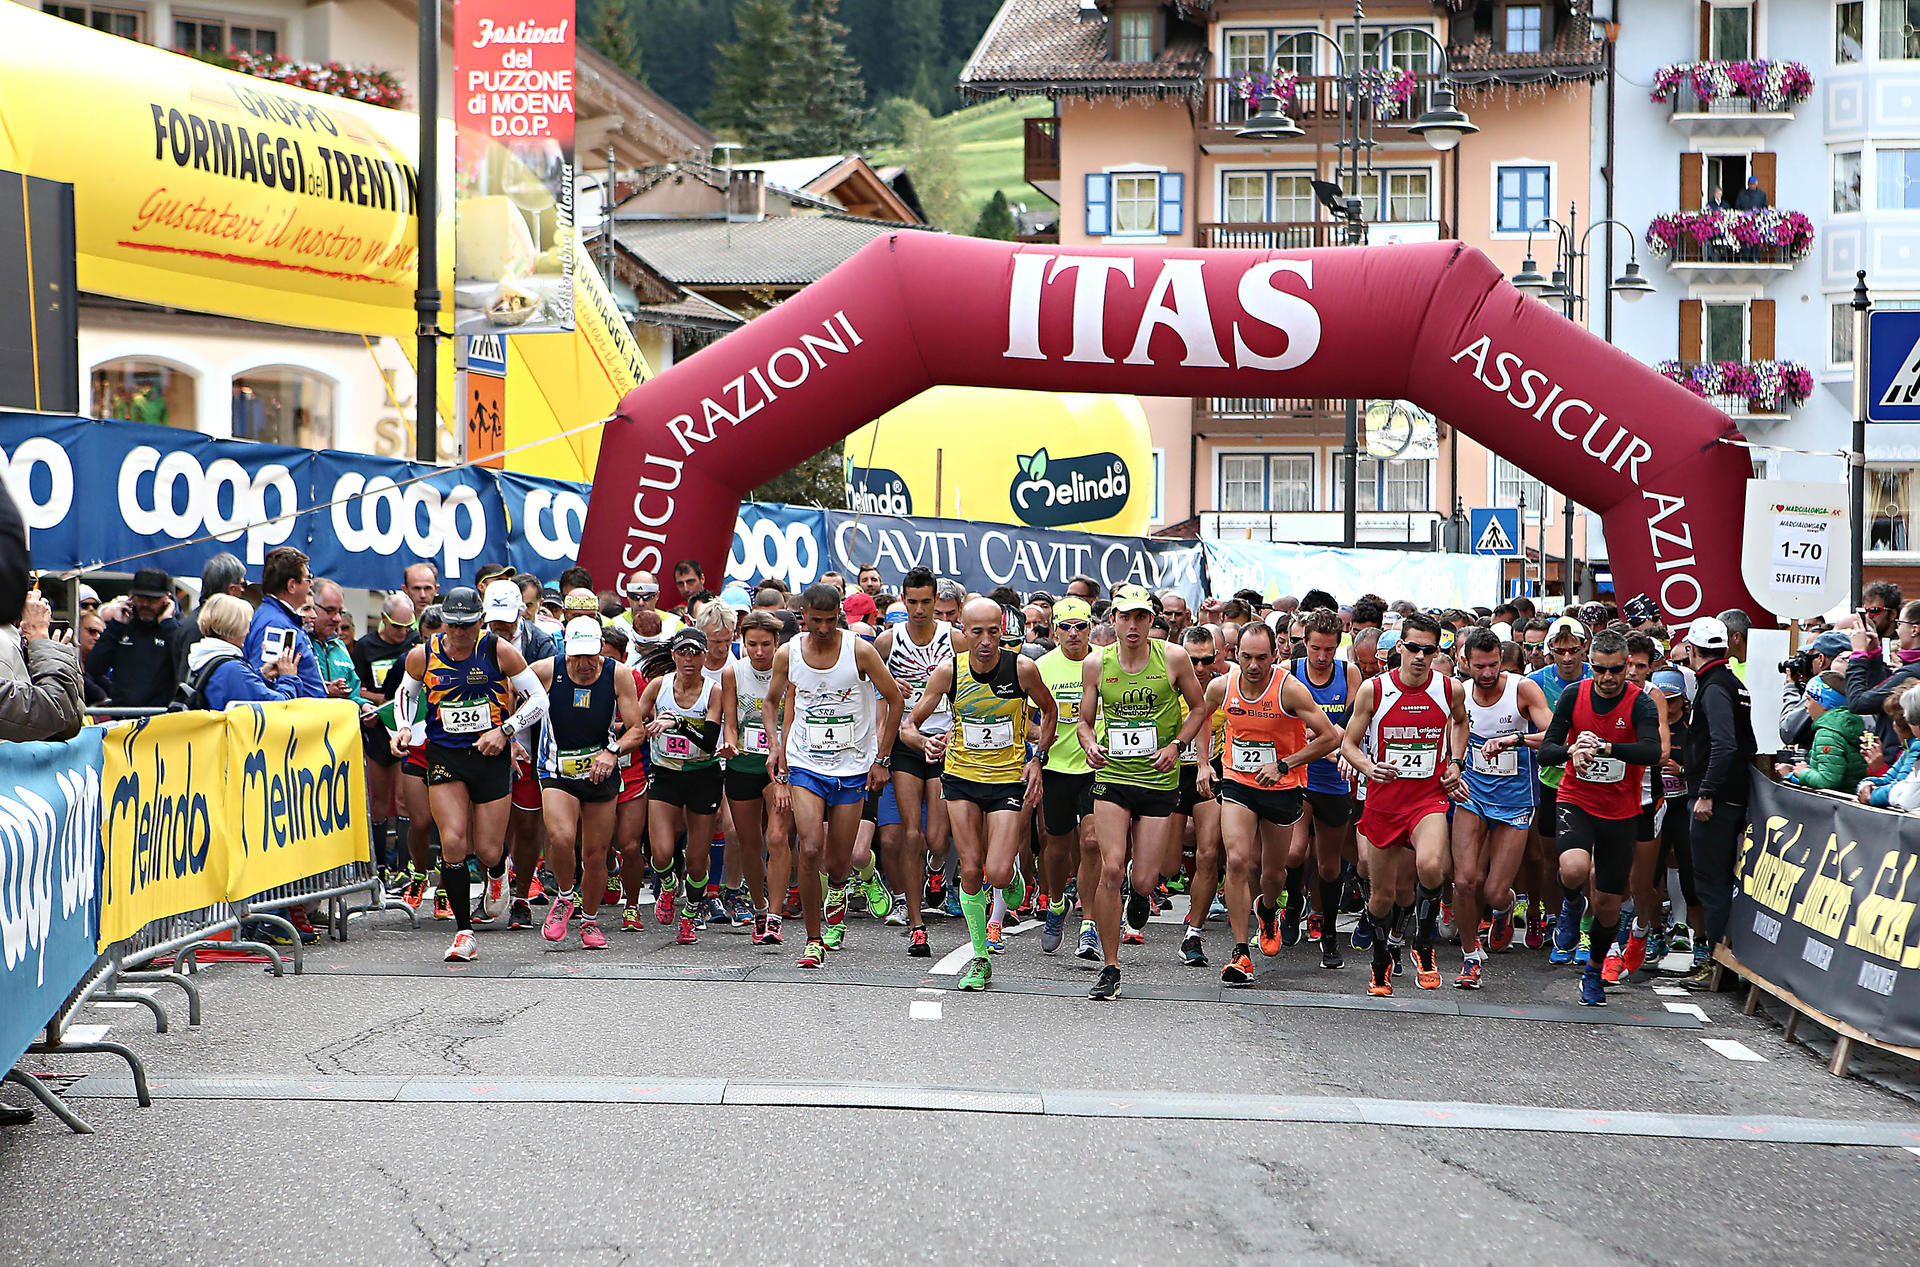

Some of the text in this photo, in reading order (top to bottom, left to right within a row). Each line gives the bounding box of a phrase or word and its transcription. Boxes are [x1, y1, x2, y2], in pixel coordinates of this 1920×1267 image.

[472, 18, 568, 48] Festival
[502, 48, 533, 69] del
[468, 70, 573, 91] PUZZONE
[228, 81, 339, 137] GRUPPO
[467, 93, 573, 114] di MOENA
[490, 115, 552, 136] D.O.P.
[150, 103, 419, 217] FORMAGGI del TRENTIN
[555, 163, 574, 227] Moena
[132, 187, 264, 244] Gustatevi
[265, 206, 297, 249] il
[290, 221, 362, 262] nostro
[1003, 252, 1322, 371] ITAS
[1017, 466, 1127, 509] Melinda
[118, 445, 298, 565] coop
[331, 472, 486, 578] coop
[834, 521, 967, 576] CAVIT
[980, 531, 1092, 584] CAVIT
[1781, 541, 1822, 560] 1-70
[1776, 573, 1820, 585] STAFFETTA
[451, 710, 480, 724] 236
[818, 708, 835, 716] SRB
[1248, 709, 1282, 719] Bisson
[668, 737, 687, 751] 34
[825, 728, 835, 740] 4
[982, 728, 992, 740] 2
[1122, 732, 1140, 746] 16
[575, 757, 592, 771] 52
[1242, 750, 1261, 763] 22
[1402, 754, 1422, 767] 24
[1590, 761, 1610, 772] 25
[242, 722, 350, 858] Melinda
[108, 742, 211, 906] Melinda
